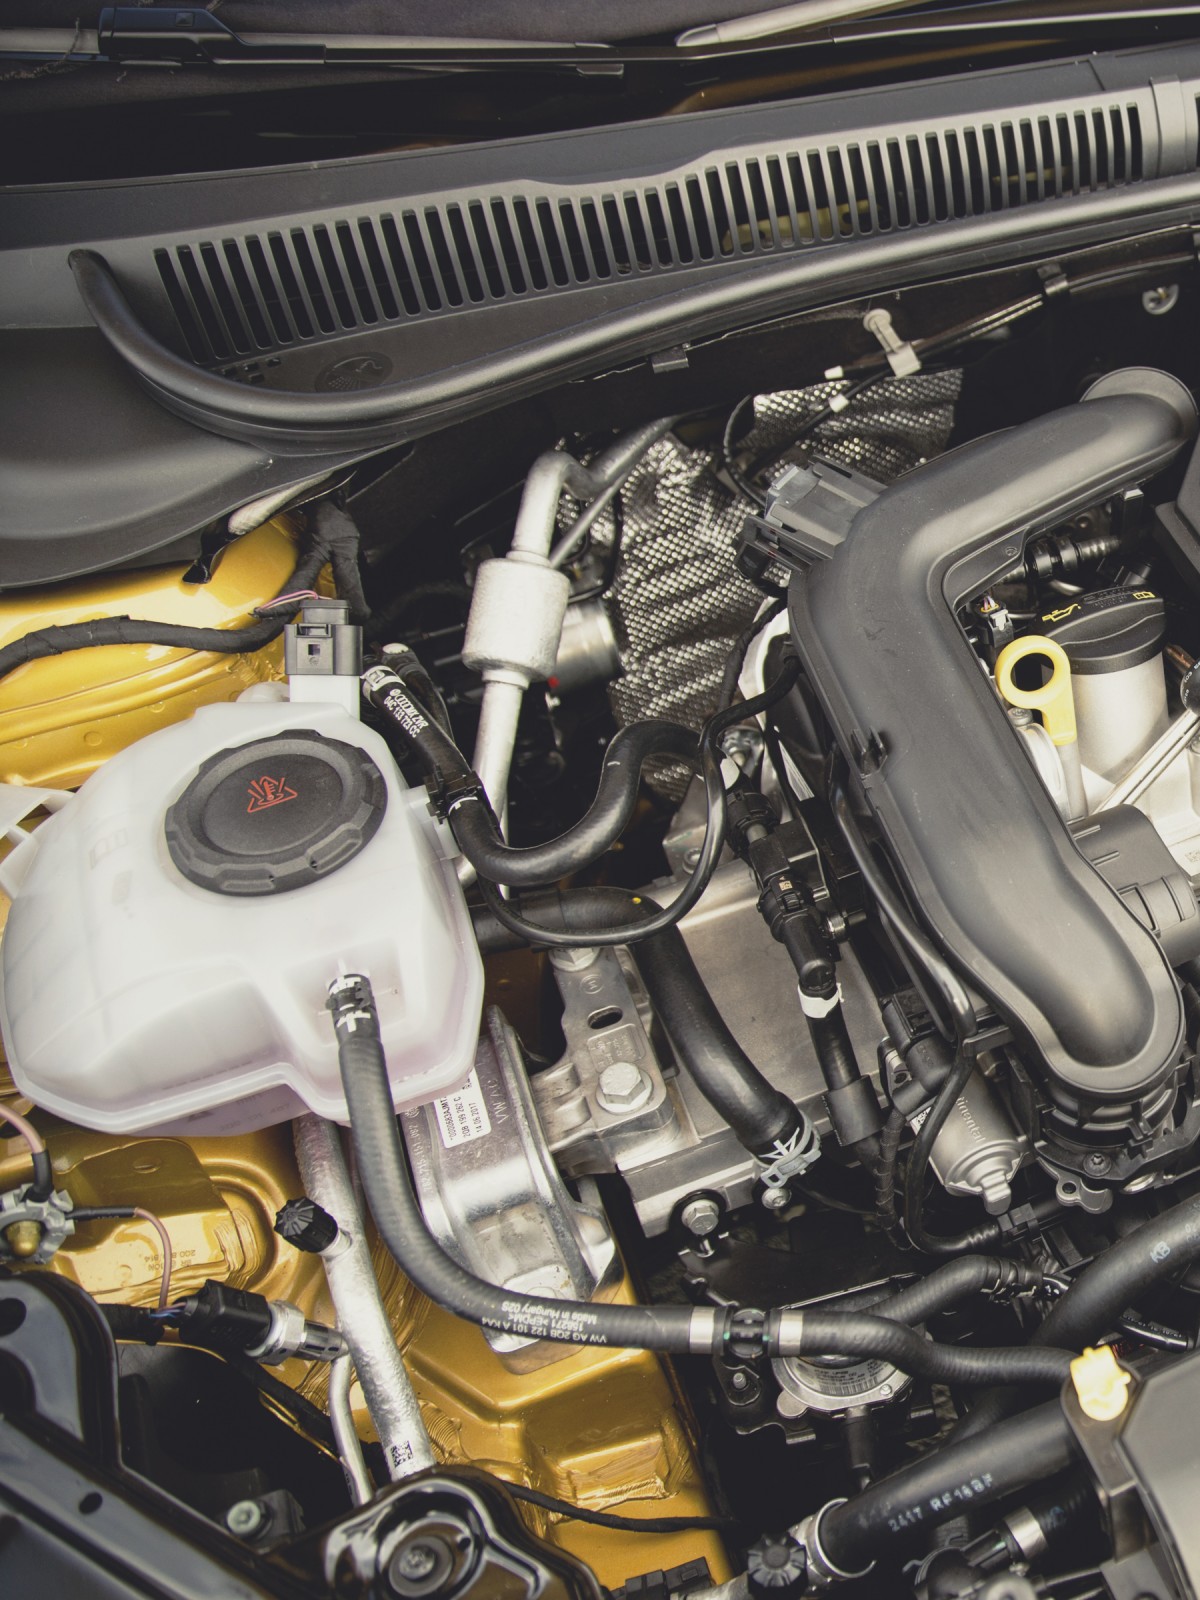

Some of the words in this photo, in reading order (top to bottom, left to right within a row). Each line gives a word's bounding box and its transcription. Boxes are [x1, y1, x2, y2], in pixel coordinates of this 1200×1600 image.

[492, 1100, 509, 1123] VW
[457, 1113, 466, 1124] 199
[955, 1096, 985, 1142] tinental
[522, 1303, 559, 1318] Hungary
[571, 1312, 597, 1323] Made
[502, 1321, 510, 1329] A
[512, 1323, 528, 1331] 101
[530, 1325, 547, 1335] 122
[571, 1332, 587, 1341] AG
[589, 1334, 606, 1342] VW
